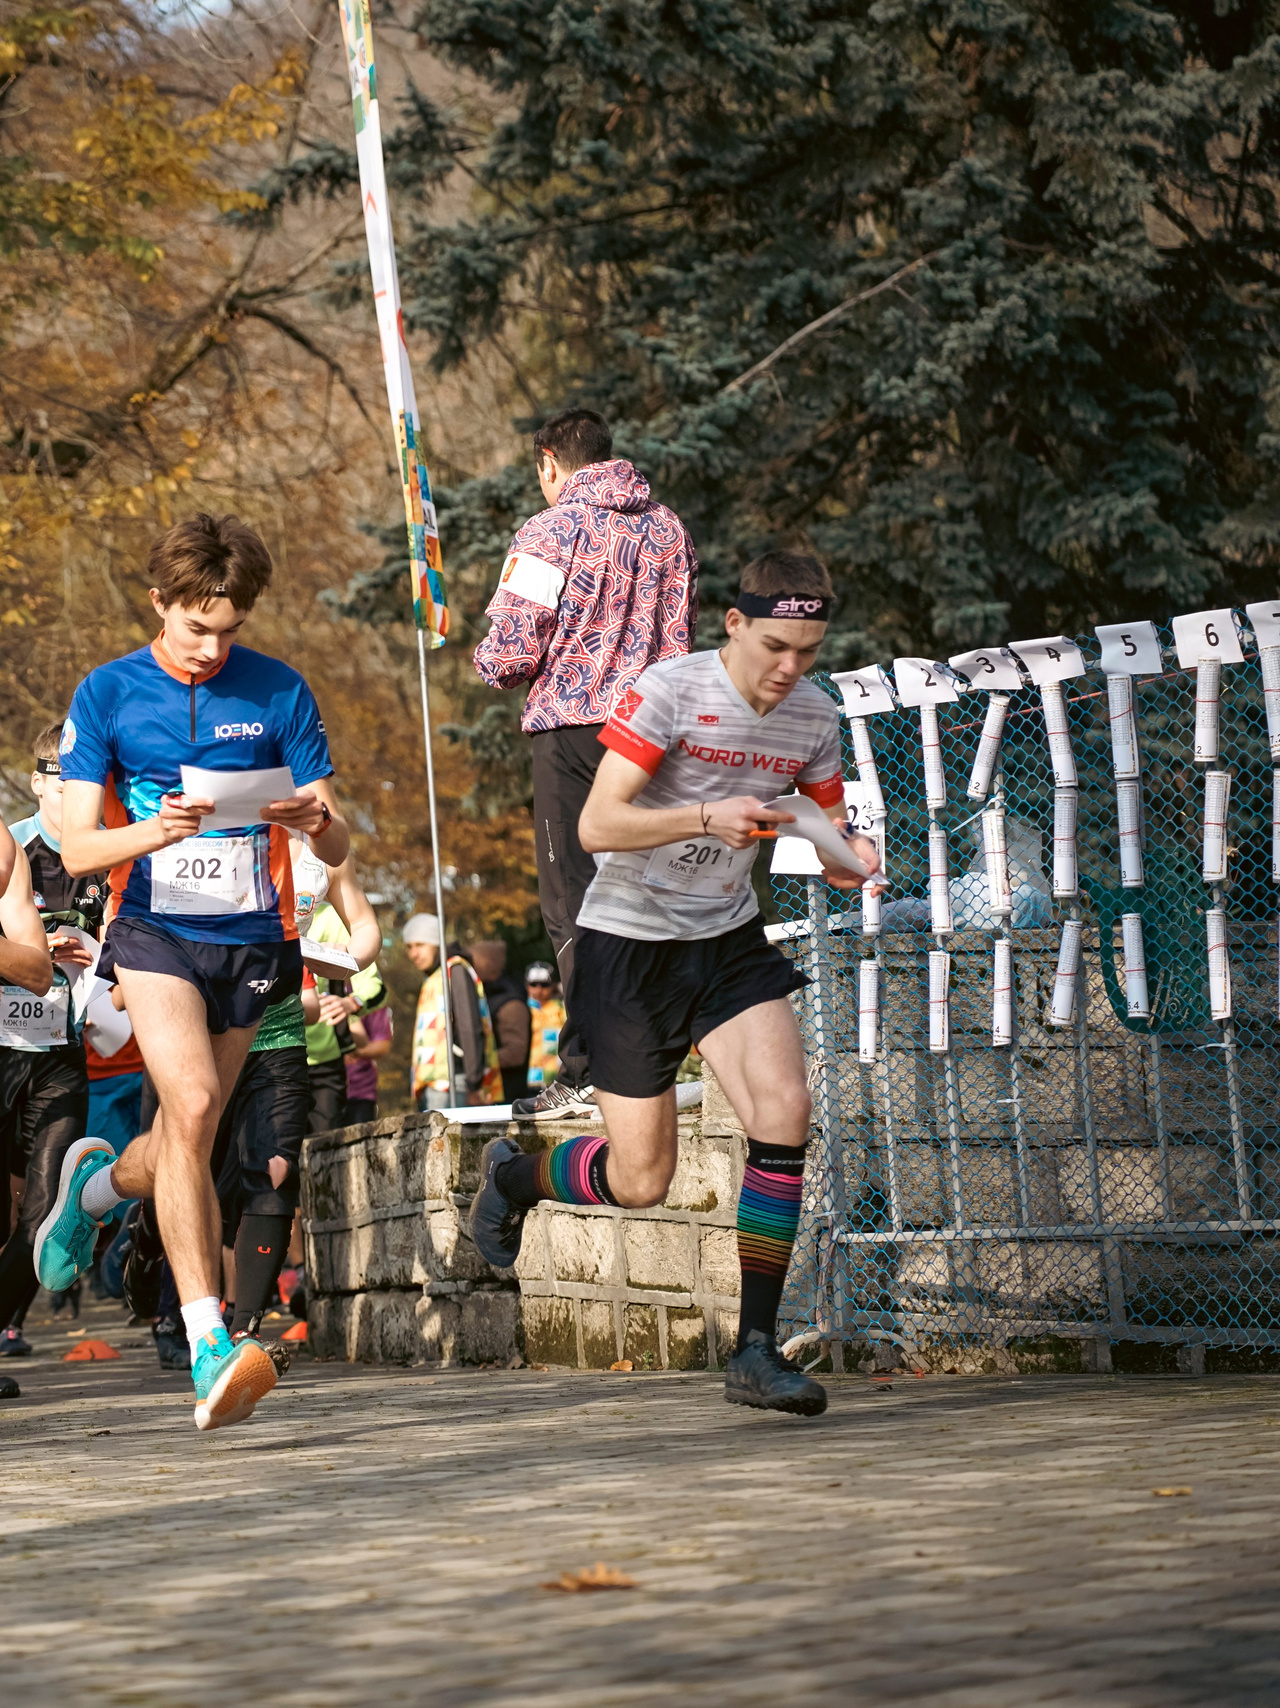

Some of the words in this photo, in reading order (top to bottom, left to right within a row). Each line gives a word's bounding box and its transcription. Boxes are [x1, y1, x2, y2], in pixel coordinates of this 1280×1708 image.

[771, 610, 805, 618] Compass
[1205, 623, 1220, 647] 6
[1045, 647, 1061, 662] 4
[1121, 634, 1137, 656] 5
[975, 656, 996, 674] 3
[921, 667, 937, 687] 2
[853, 679, 870, 698] 1
[678, 739, 746, 768] NORD
[753, 752, 809, 776] WES
[678, 843, 722, 865] 201
[727, 855, 734, 868] 1
[175, 858, 222, 880] 202
[231, 867, 237, 881] 1
[668, 860, 700, 875] МЖ16
[169, 880, 201, 891] МЖ16
[8, 1001, 44, 1019] 208
[49, 1009, 55, 1020] 1
[3, 1019, 28, 1028] МЖ16
